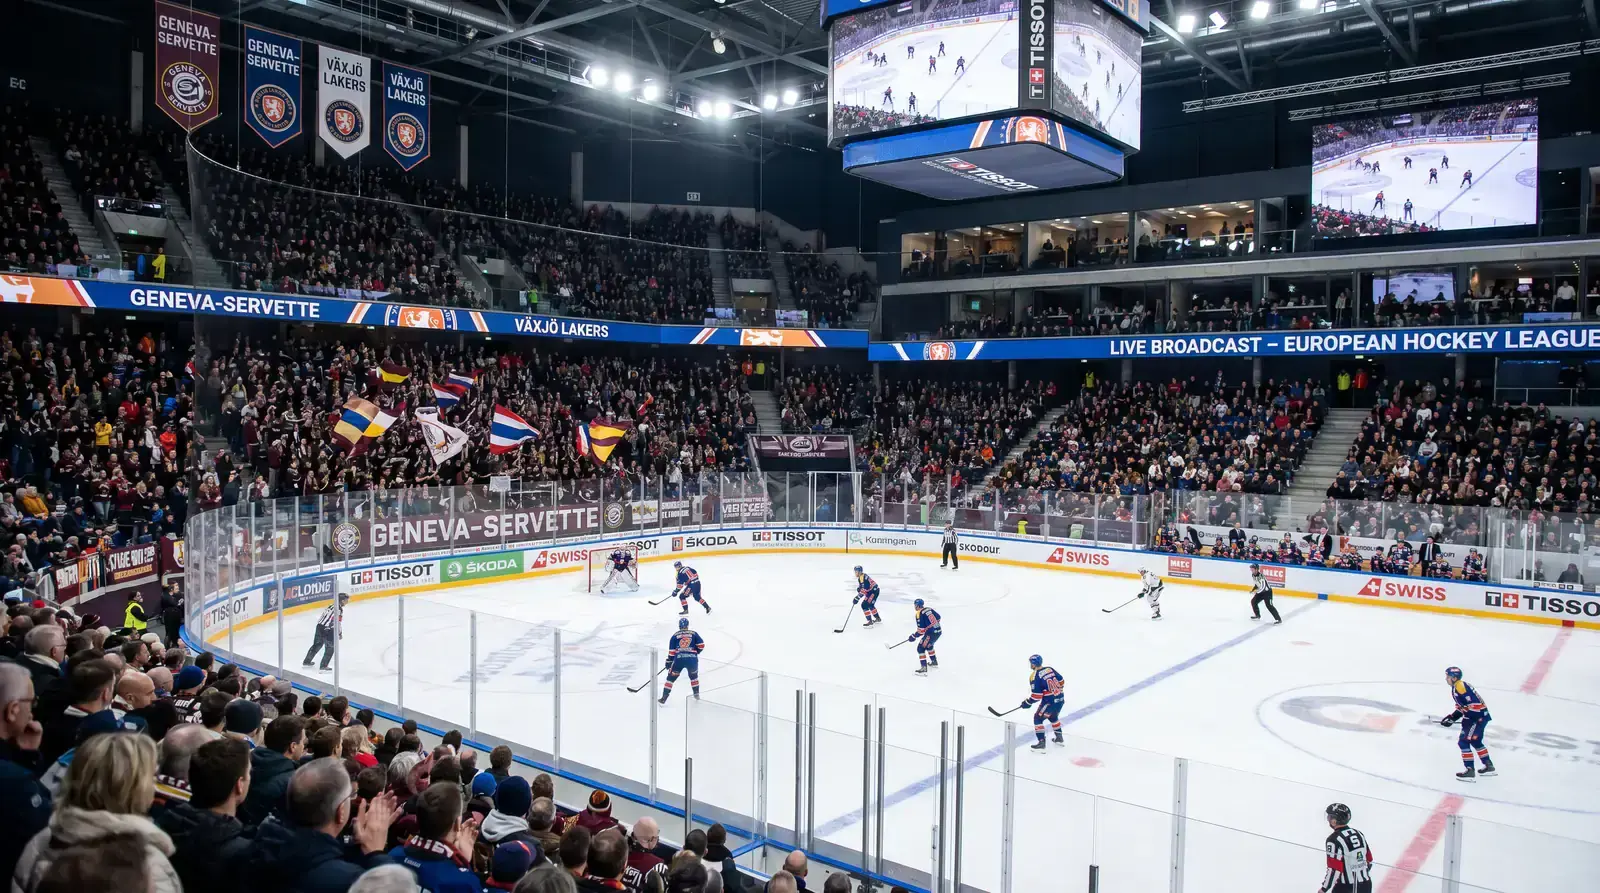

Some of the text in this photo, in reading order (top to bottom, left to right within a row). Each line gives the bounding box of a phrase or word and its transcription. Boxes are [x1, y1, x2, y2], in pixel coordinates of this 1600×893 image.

[158, 15, 217, 40] GENEVA-
[158, 31, 217, 56] SERVETTE
[247, 38, 300, 61] GENEVA-
[168, 64, 206, 82] GENEVA
[247, 53, 300, 77] SERVETTE
[326, 56, 363, 77] VÄXJÖ
[323, 72, 366, 93] LAKERS
[390, 72, 423, 92] VÄXJÖ
[387, 87, 426, 106] LAKERS
[967, 167, 1040, 190] TISSOT
[130, 288, 320, 318] GENEVA-SERVETTE
[514, 316, 609, 338] VÄXJÖ LAKERS
[1110, 340, 1147, 356] LIVE
[1150, 336, 1262, 355] BROADCAST
[1284, 333, 1397, 353] EUROPEAN
[1403, 331, 1498, 350] HOCKEY
[1505, 329, 1600, 349] LEAGUE
[372, 507, 599, 548] GENEVA-SERVETTE
[773, 531, 825, 541] TISSOT
[686, 536, 738, 548] ŠKODA
[466, 558, 518, 574] ŠKODA
[550, 550, 588, 565] SWISS
[1066, 551, 1109, 566] SWISS
[375, 564, 434, 582] TISSOT
[1385, 582, 1446, 601] SWISS
[211, 596, 249, 625] TISSOT
